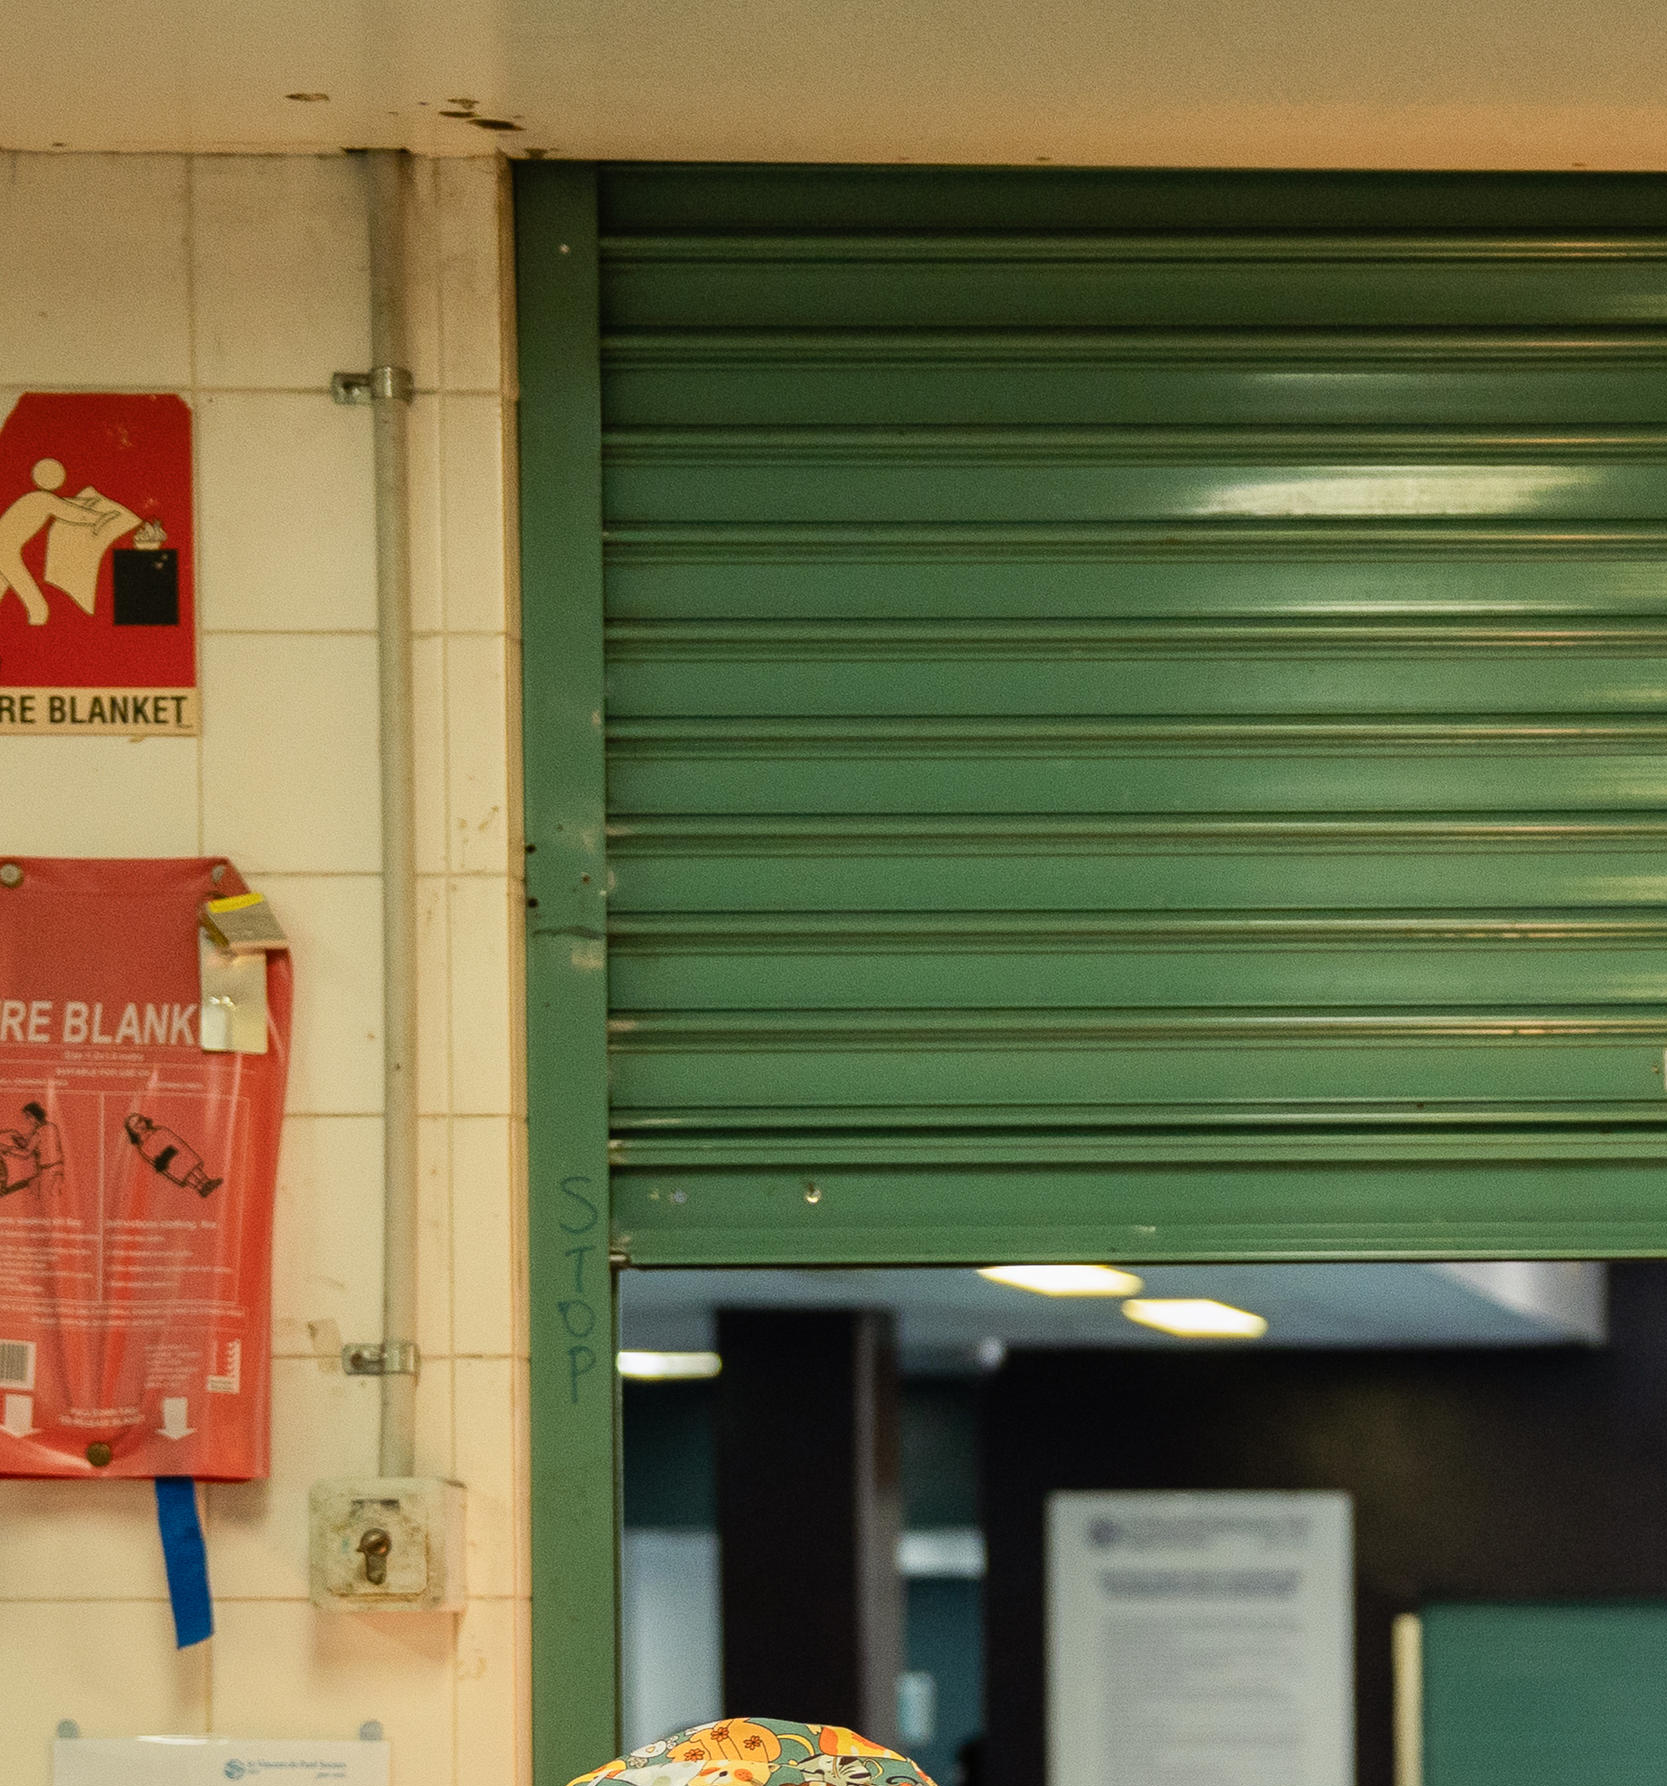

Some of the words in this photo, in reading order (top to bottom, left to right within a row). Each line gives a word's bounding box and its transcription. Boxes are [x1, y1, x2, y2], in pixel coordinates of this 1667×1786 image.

[0, 695, 36, 724] RE
[49, 695, 188, 725] BLANKET
[0, 999, 53, 1043] RE
[63, 1000, 201, 1045] BLANK
[558, 1176, 599, 1404] STOP
